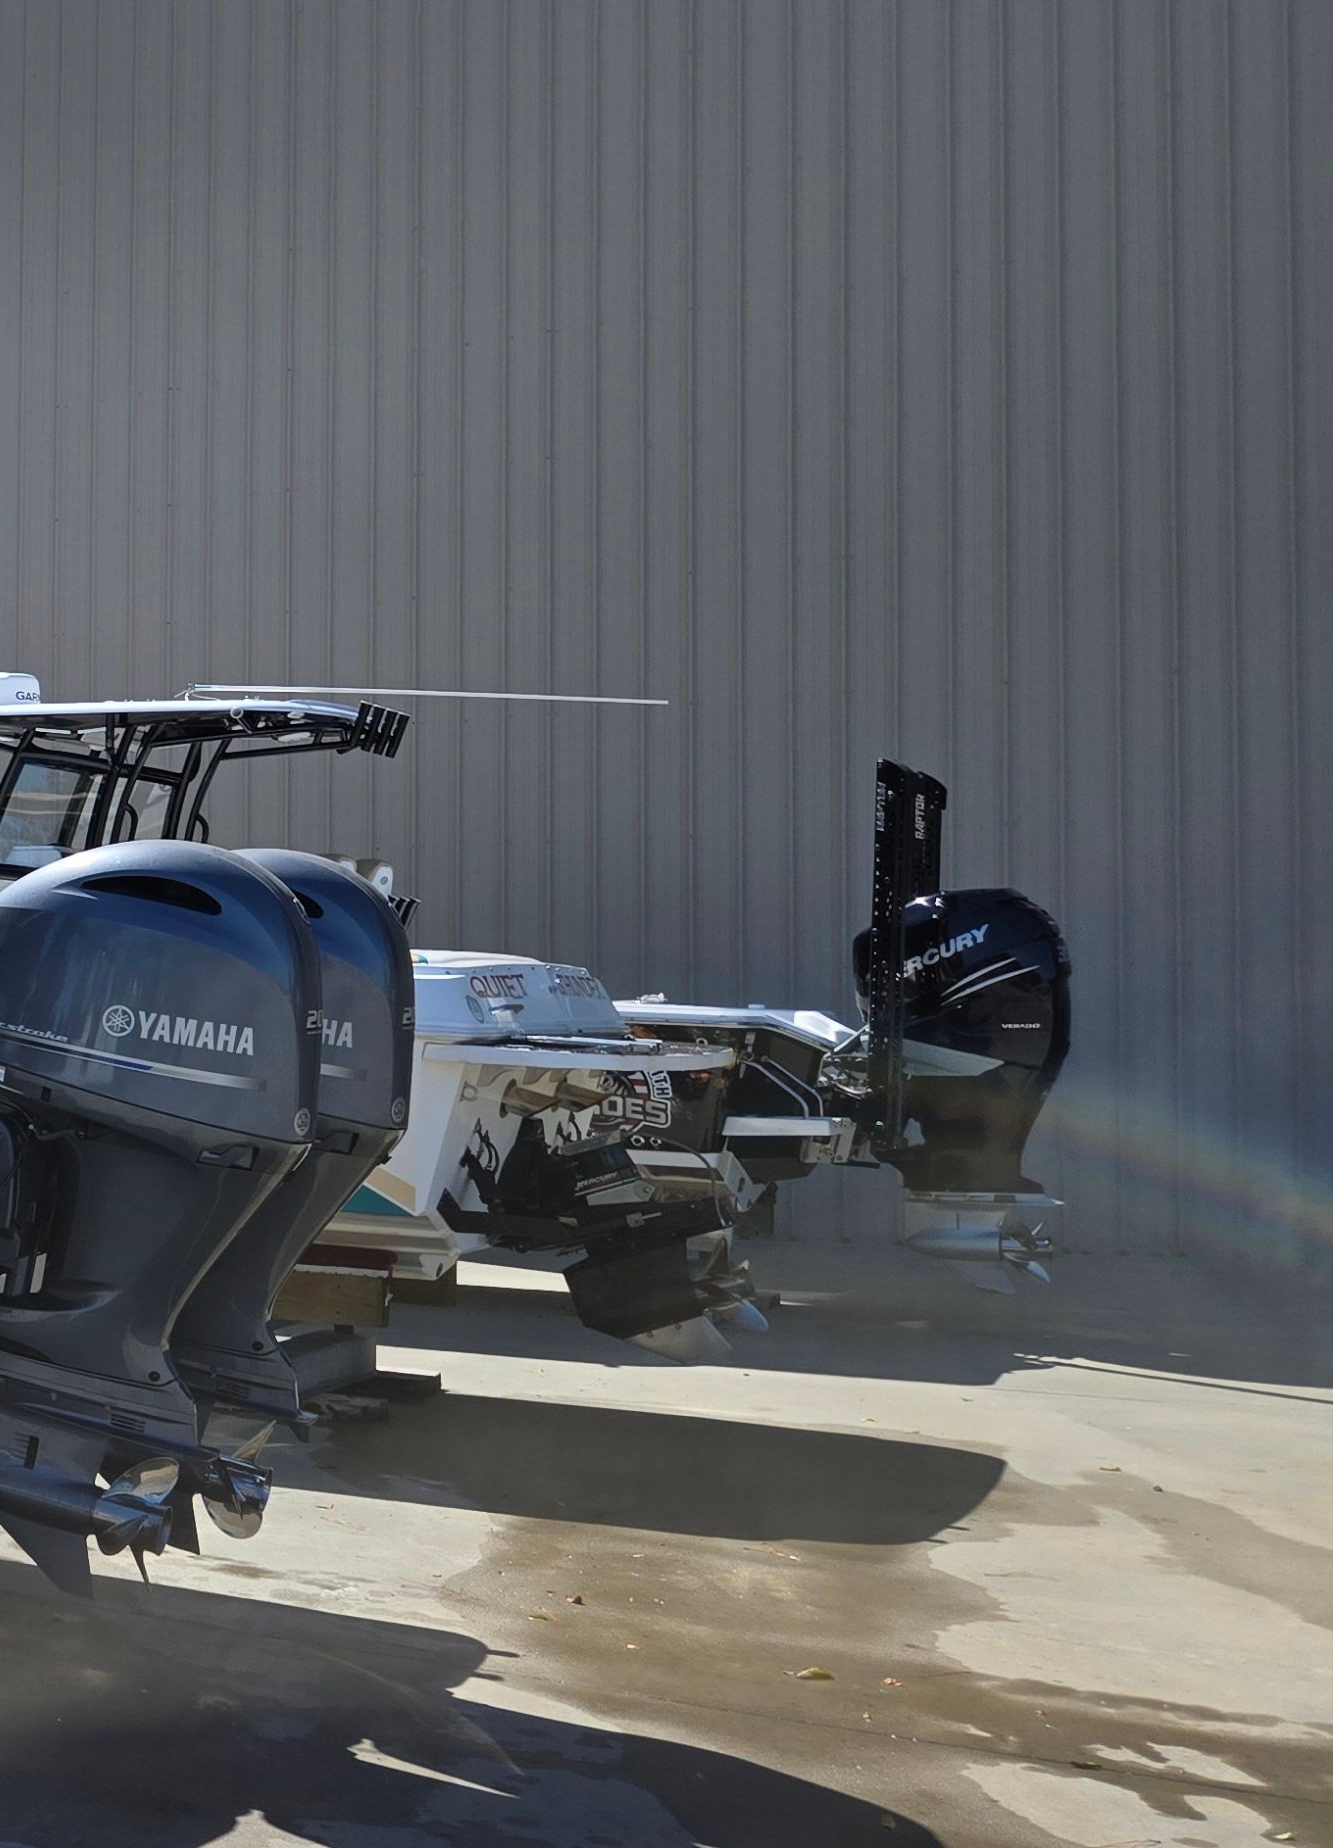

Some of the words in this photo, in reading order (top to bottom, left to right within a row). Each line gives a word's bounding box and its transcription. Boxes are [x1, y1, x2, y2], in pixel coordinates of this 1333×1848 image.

[915, 793, 925, 839] RAPTOR
[470, 974, 528, 999] QUIET
[138, 1010, 253, 1056] YAMAHA
